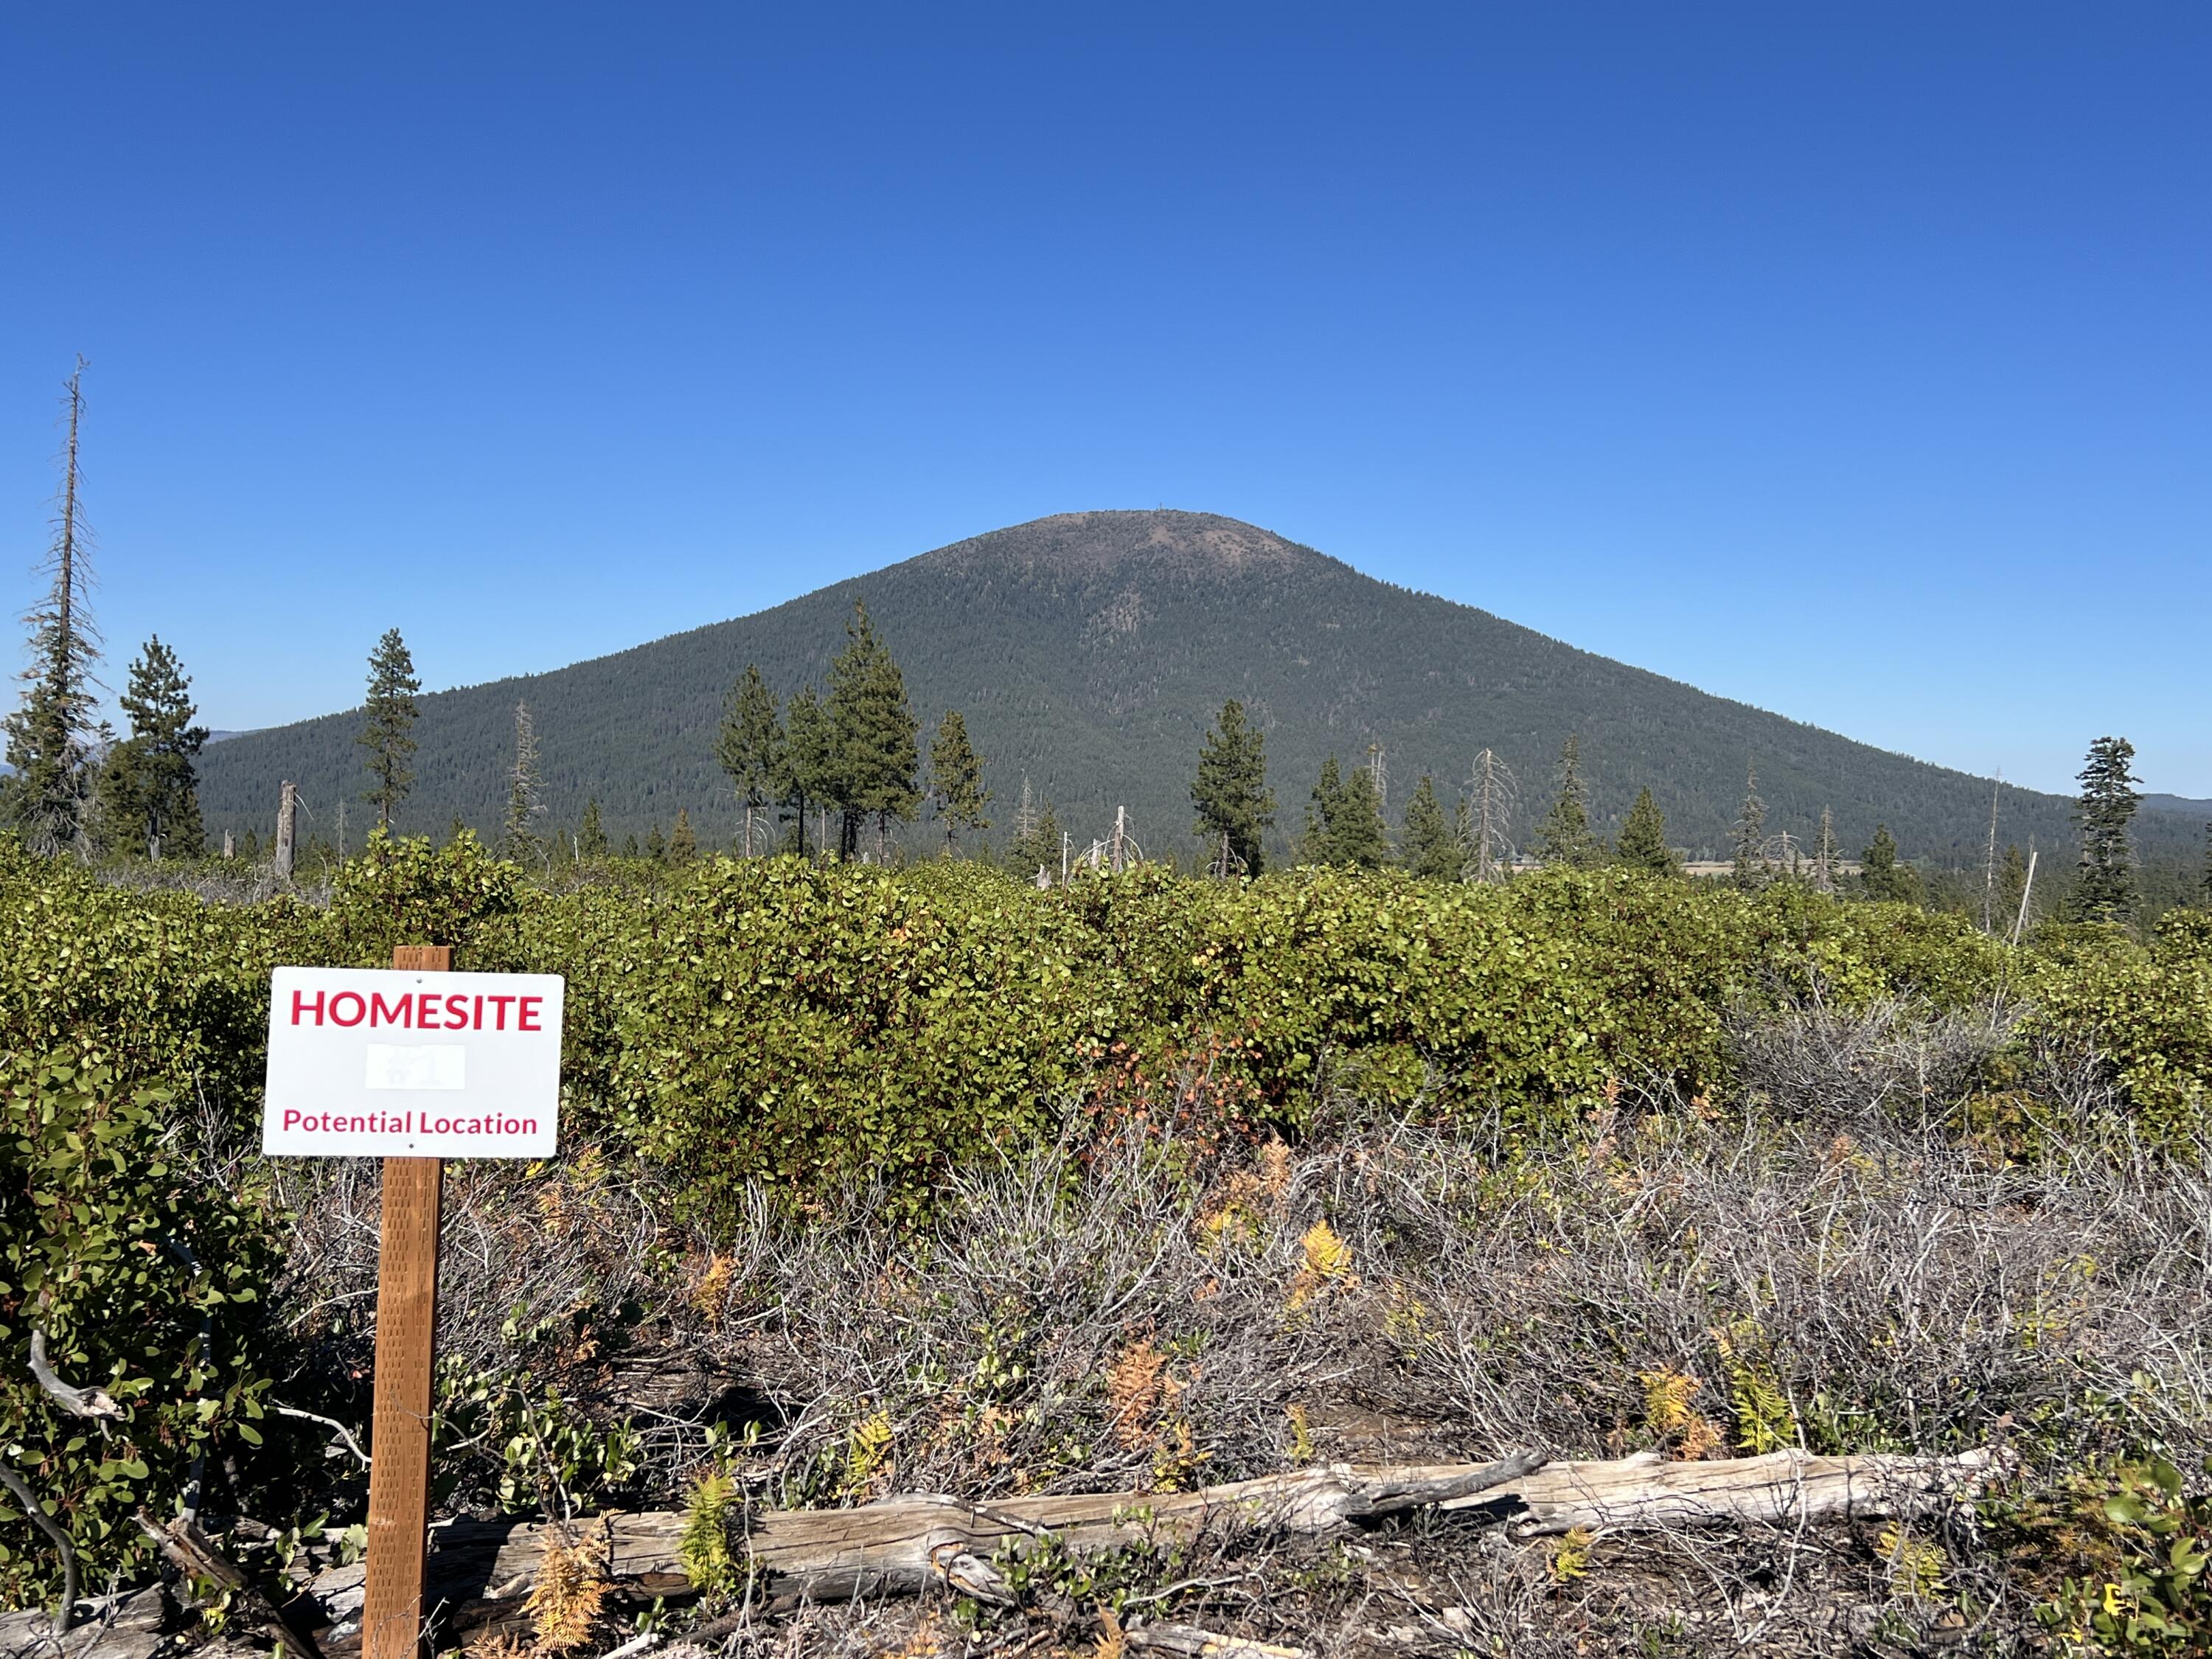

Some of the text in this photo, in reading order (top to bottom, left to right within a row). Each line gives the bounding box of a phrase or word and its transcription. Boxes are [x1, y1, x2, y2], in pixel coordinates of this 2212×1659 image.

[291, 990, 543, 1032] HOMESITE
[283, 1108, 538, 1135] Potential Location
